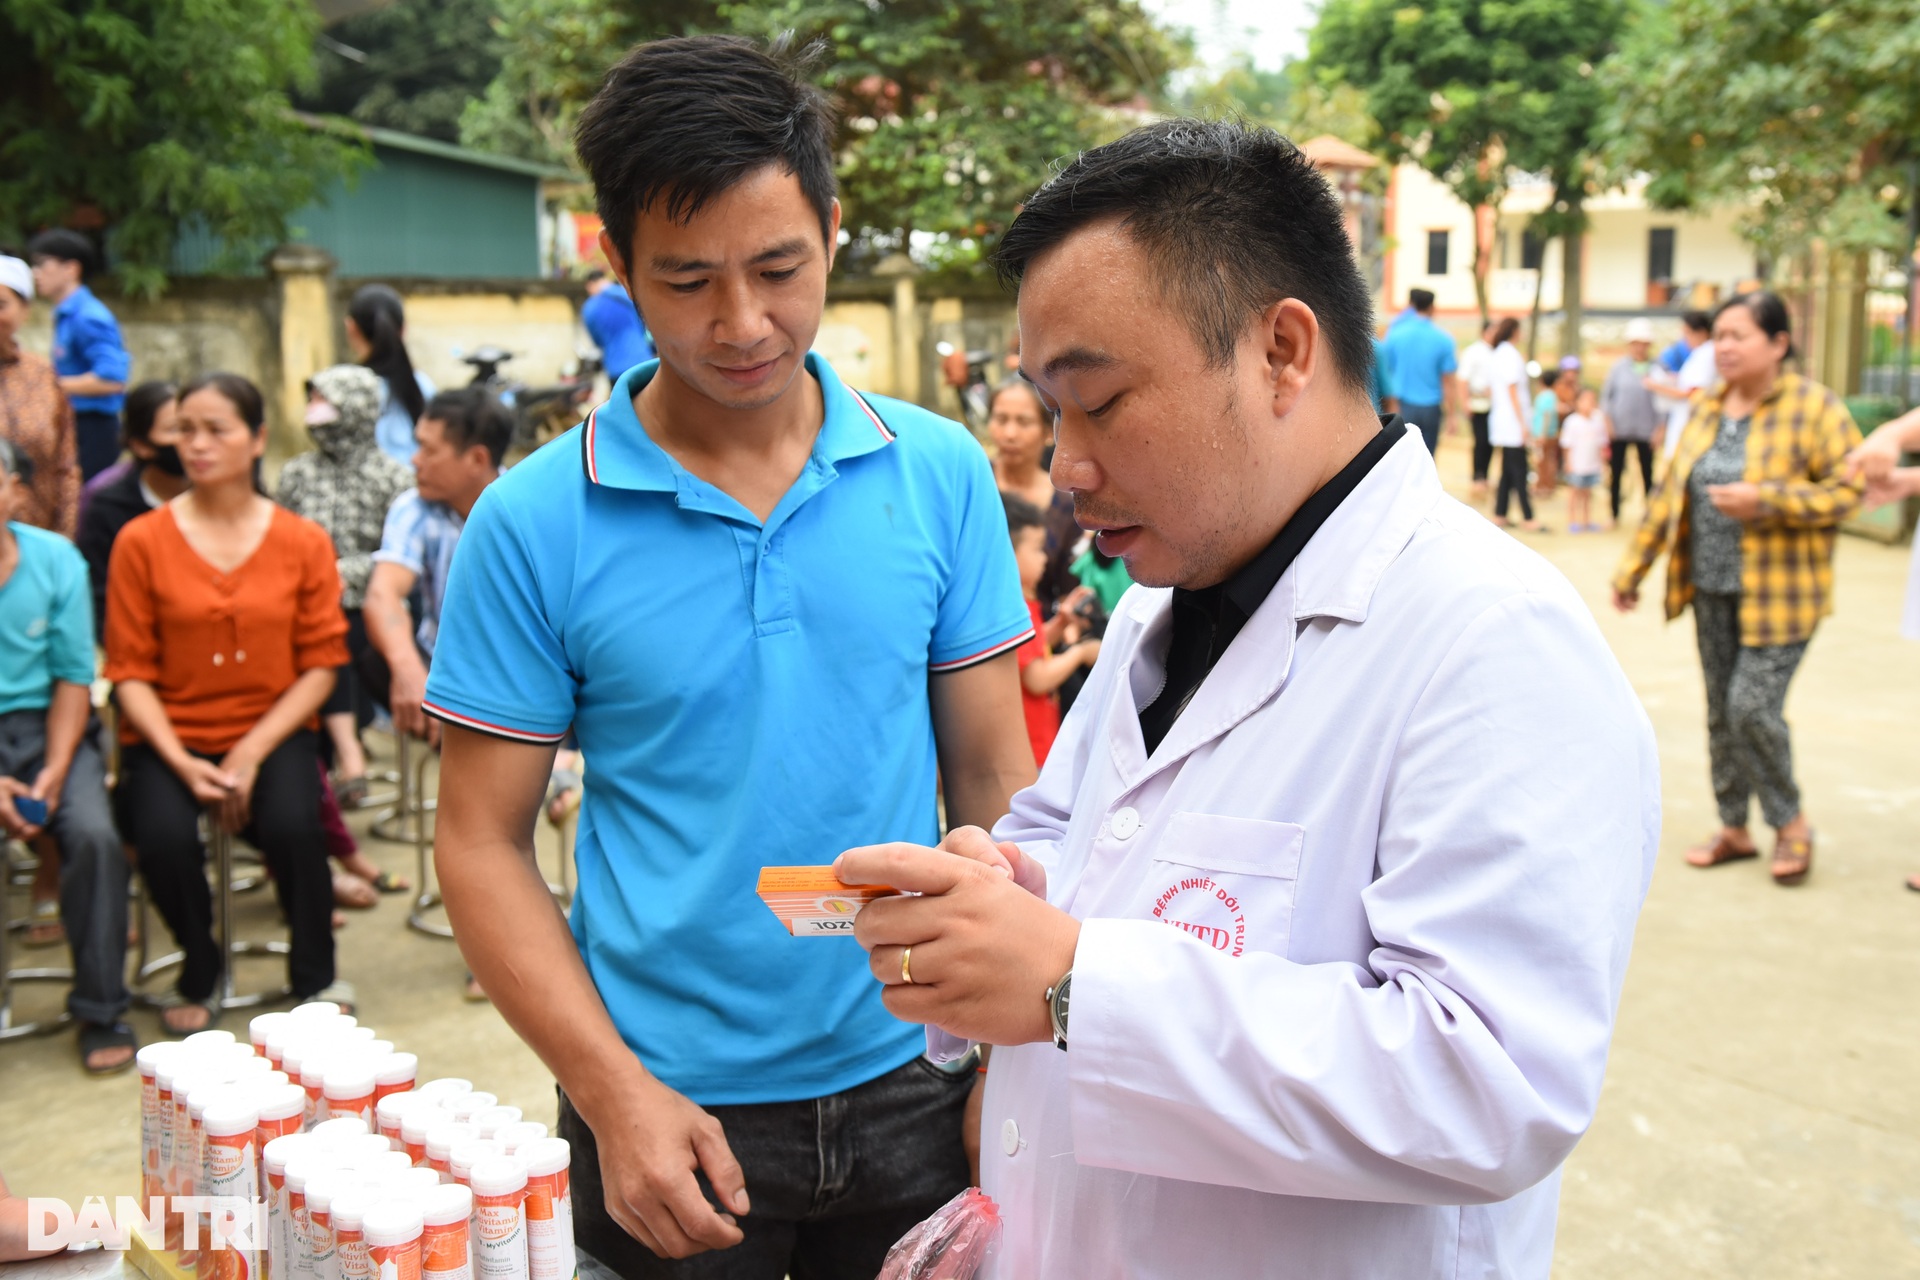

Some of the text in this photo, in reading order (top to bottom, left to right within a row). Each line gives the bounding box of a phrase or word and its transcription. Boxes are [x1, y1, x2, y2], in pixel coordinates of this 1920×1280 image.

[1153, 885, 1179, 918] BỆNH
[1181, 877, 1217, 892] NHIỆT
[1232, 914, 1245, 958] TRUN
[480, 1208, 499, 1217] Max
